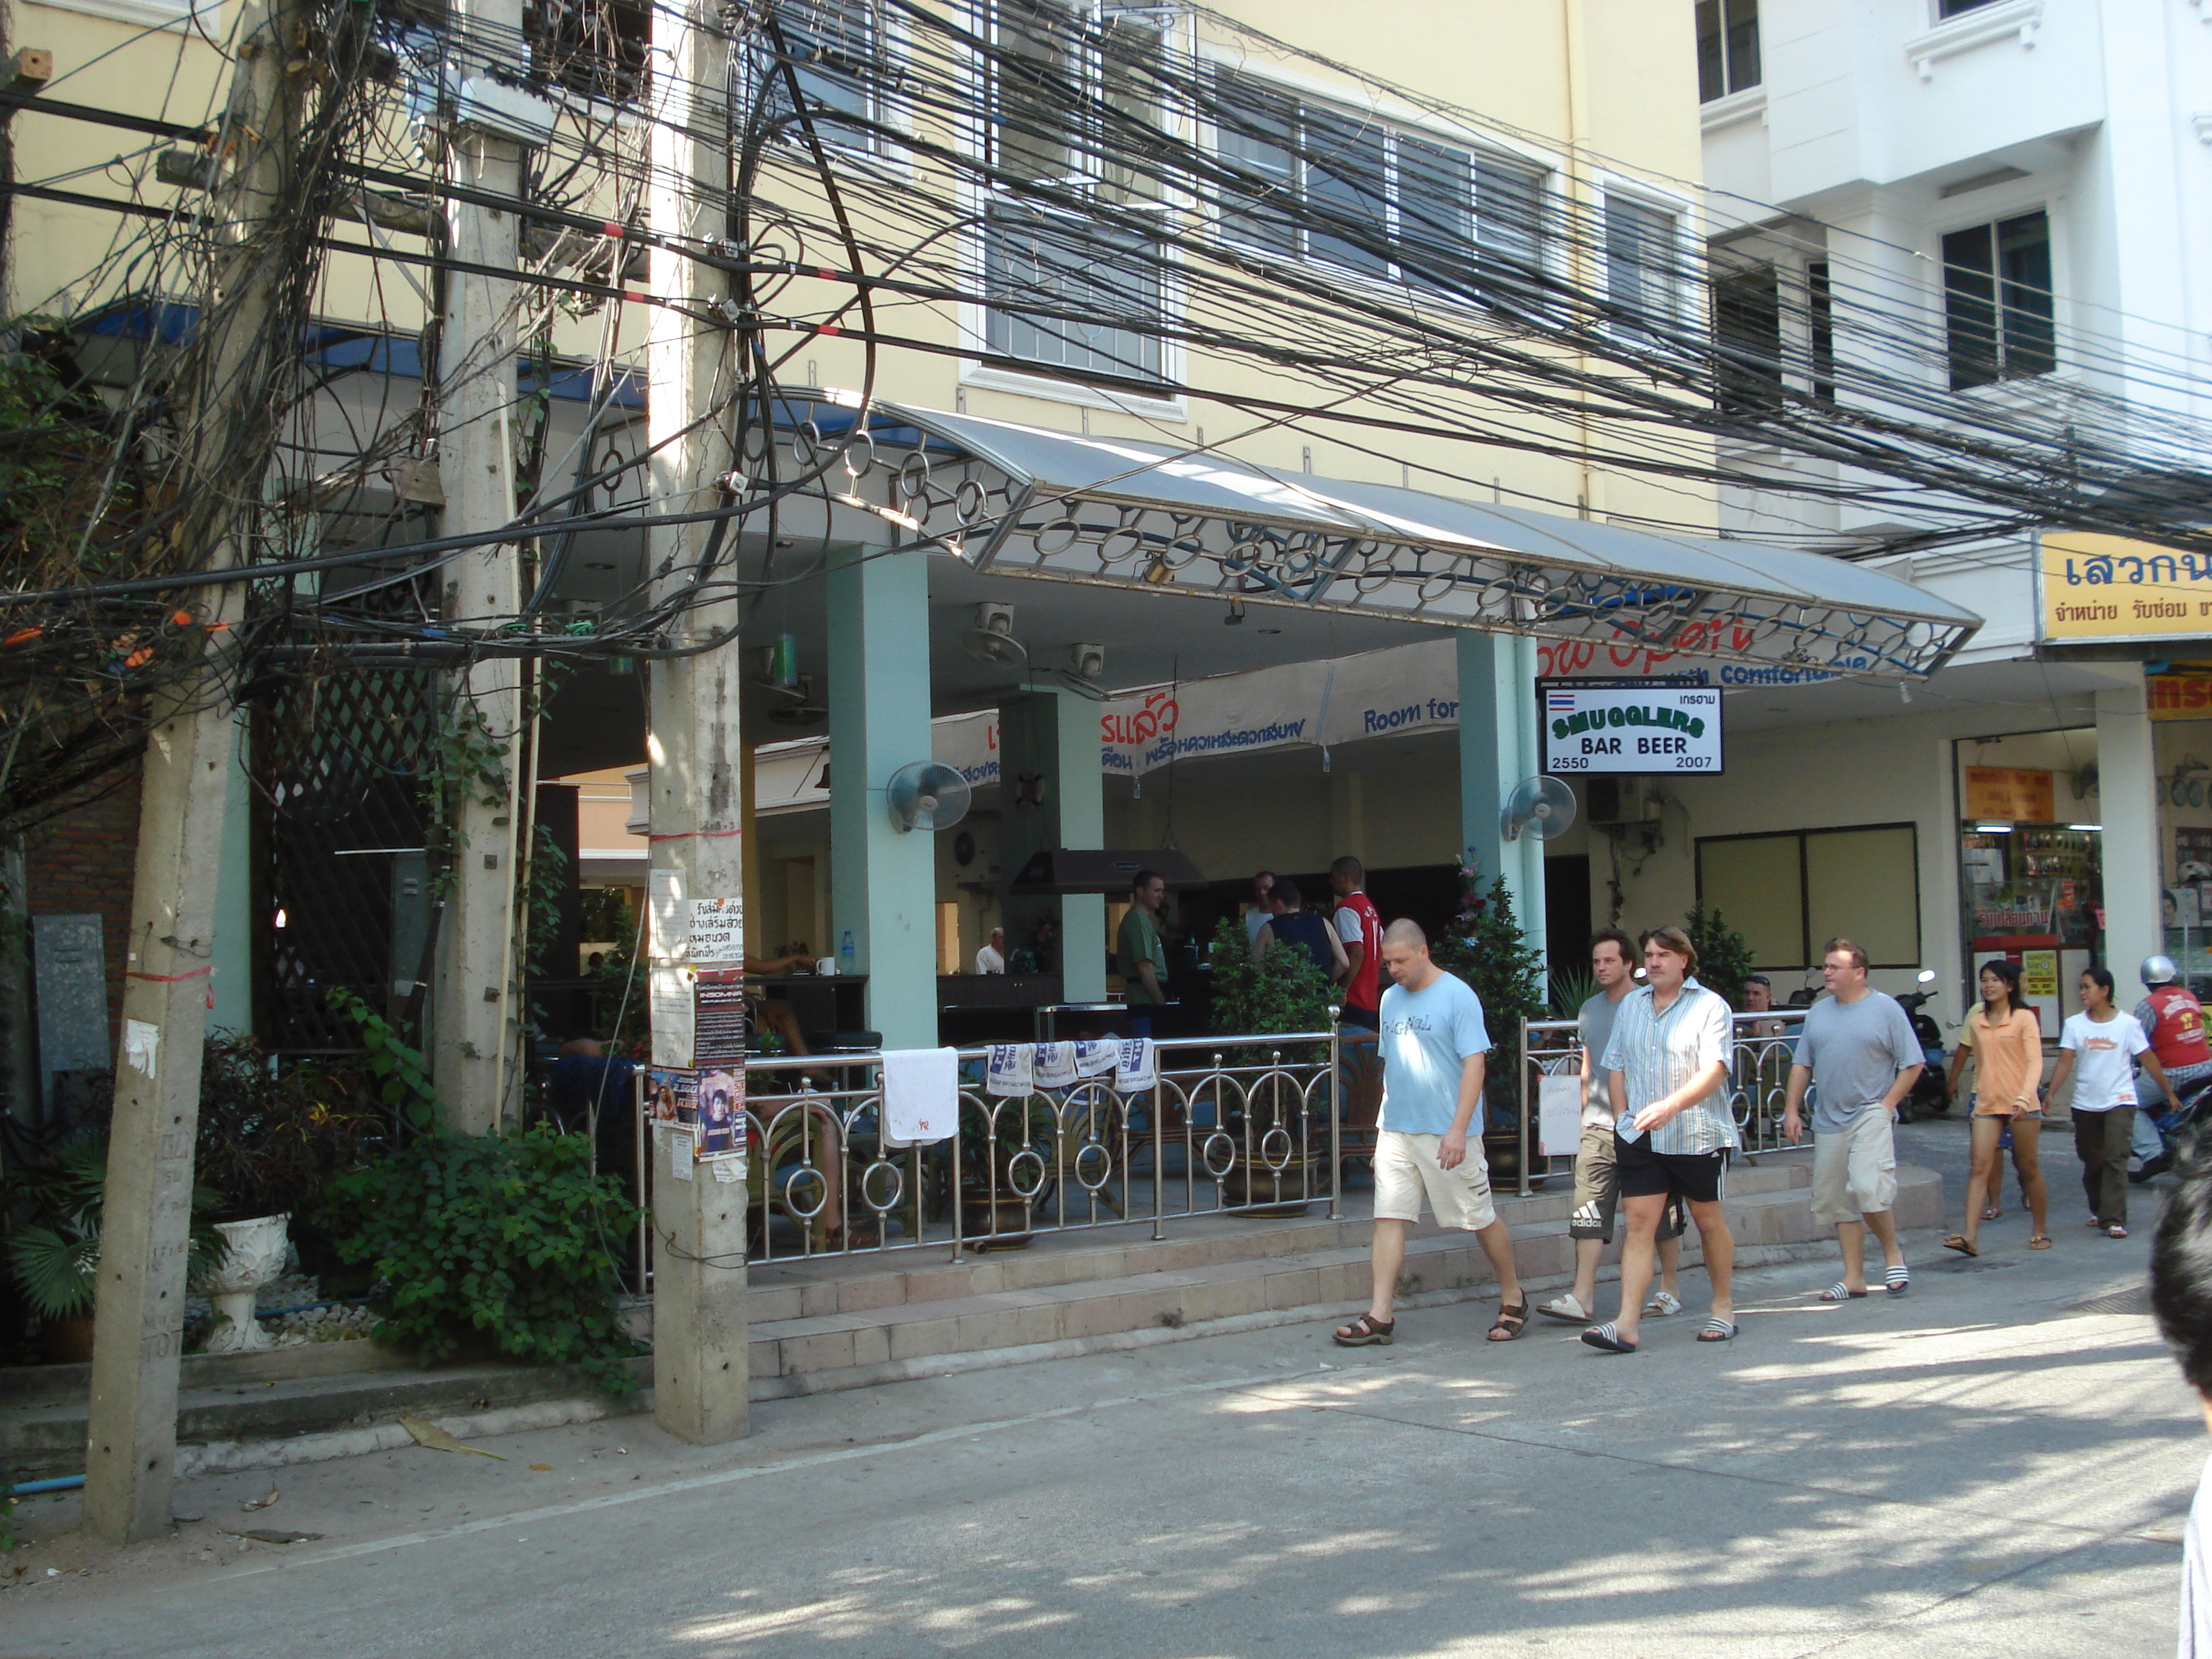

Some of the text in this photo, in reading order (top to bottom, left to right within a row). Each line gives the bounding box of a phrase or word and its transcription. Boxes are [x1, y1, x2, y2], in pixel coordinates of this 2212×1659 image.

[2055, 601, 2118, 622] จำหน่าย
[2133, 598, 2188, 619] รับซ่อม
[1363, 698, 1460, 734] Room for
[1551, 705, 1706, 740] SMUGGLERS
[1581, 737, 1688, 755] BAR BEER
[1552, 757, 1589, 768] 2550
[1676, 757, 1712, 768] 2007
[1571, 1218, 1602, 1228] adidas
